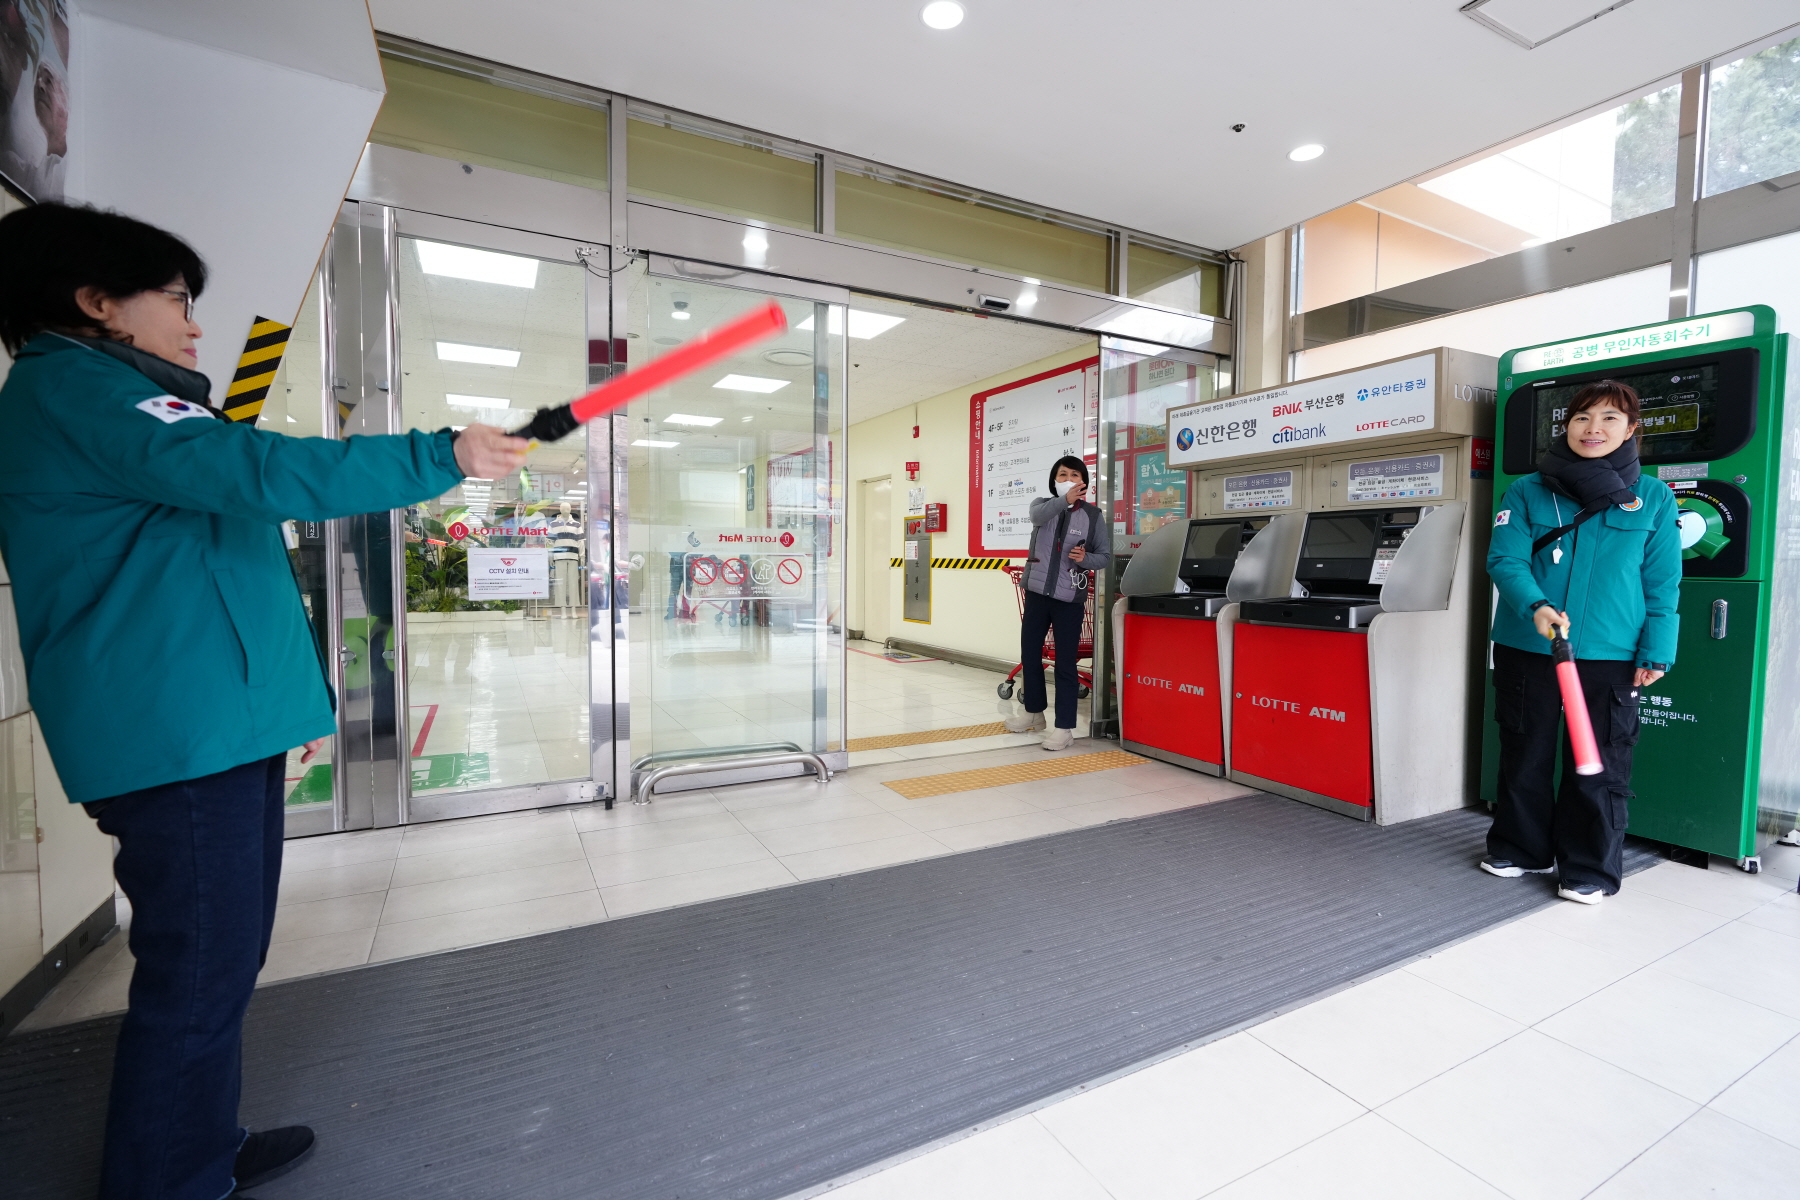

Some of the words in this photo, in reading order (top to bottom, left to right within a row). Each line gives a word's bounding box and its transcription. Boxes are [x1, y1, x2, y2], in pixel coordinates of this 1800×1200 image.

[1571, 345, 1599, 360] 공병
[1603, 323, 1711, 354] 무인자동회수기
[1543, 358, 1564, 367] EARTH
[1371, 378, 1426, 398] 유안타증권
[1272, 401, 1303, 418] BNK
[1304, 393, 1345, 411] 부산은행
[1195, 418, 1257, 446] 신한은행
[1272, 422, 1327, 444] citibank
[1385, 463, 1410, 473] 신용카드
[474, 528, 514, 536] LOTTE
[518, 526, 548, 536] Mart
[517, 567, 530, 575] 안내
[1137, 674, 1172, 690] LOTTE
[1178, 684, 1204, 696] ATM
[1252, 695, 1300, 714] LOTTE
[1308, 706, 1346, 722] ATM
[1650, 696, 1672, 707] 행동
[1638, 716, 1668, 727] 합니다.
[1643, 708, 1698, 722] 만들어집니다.
